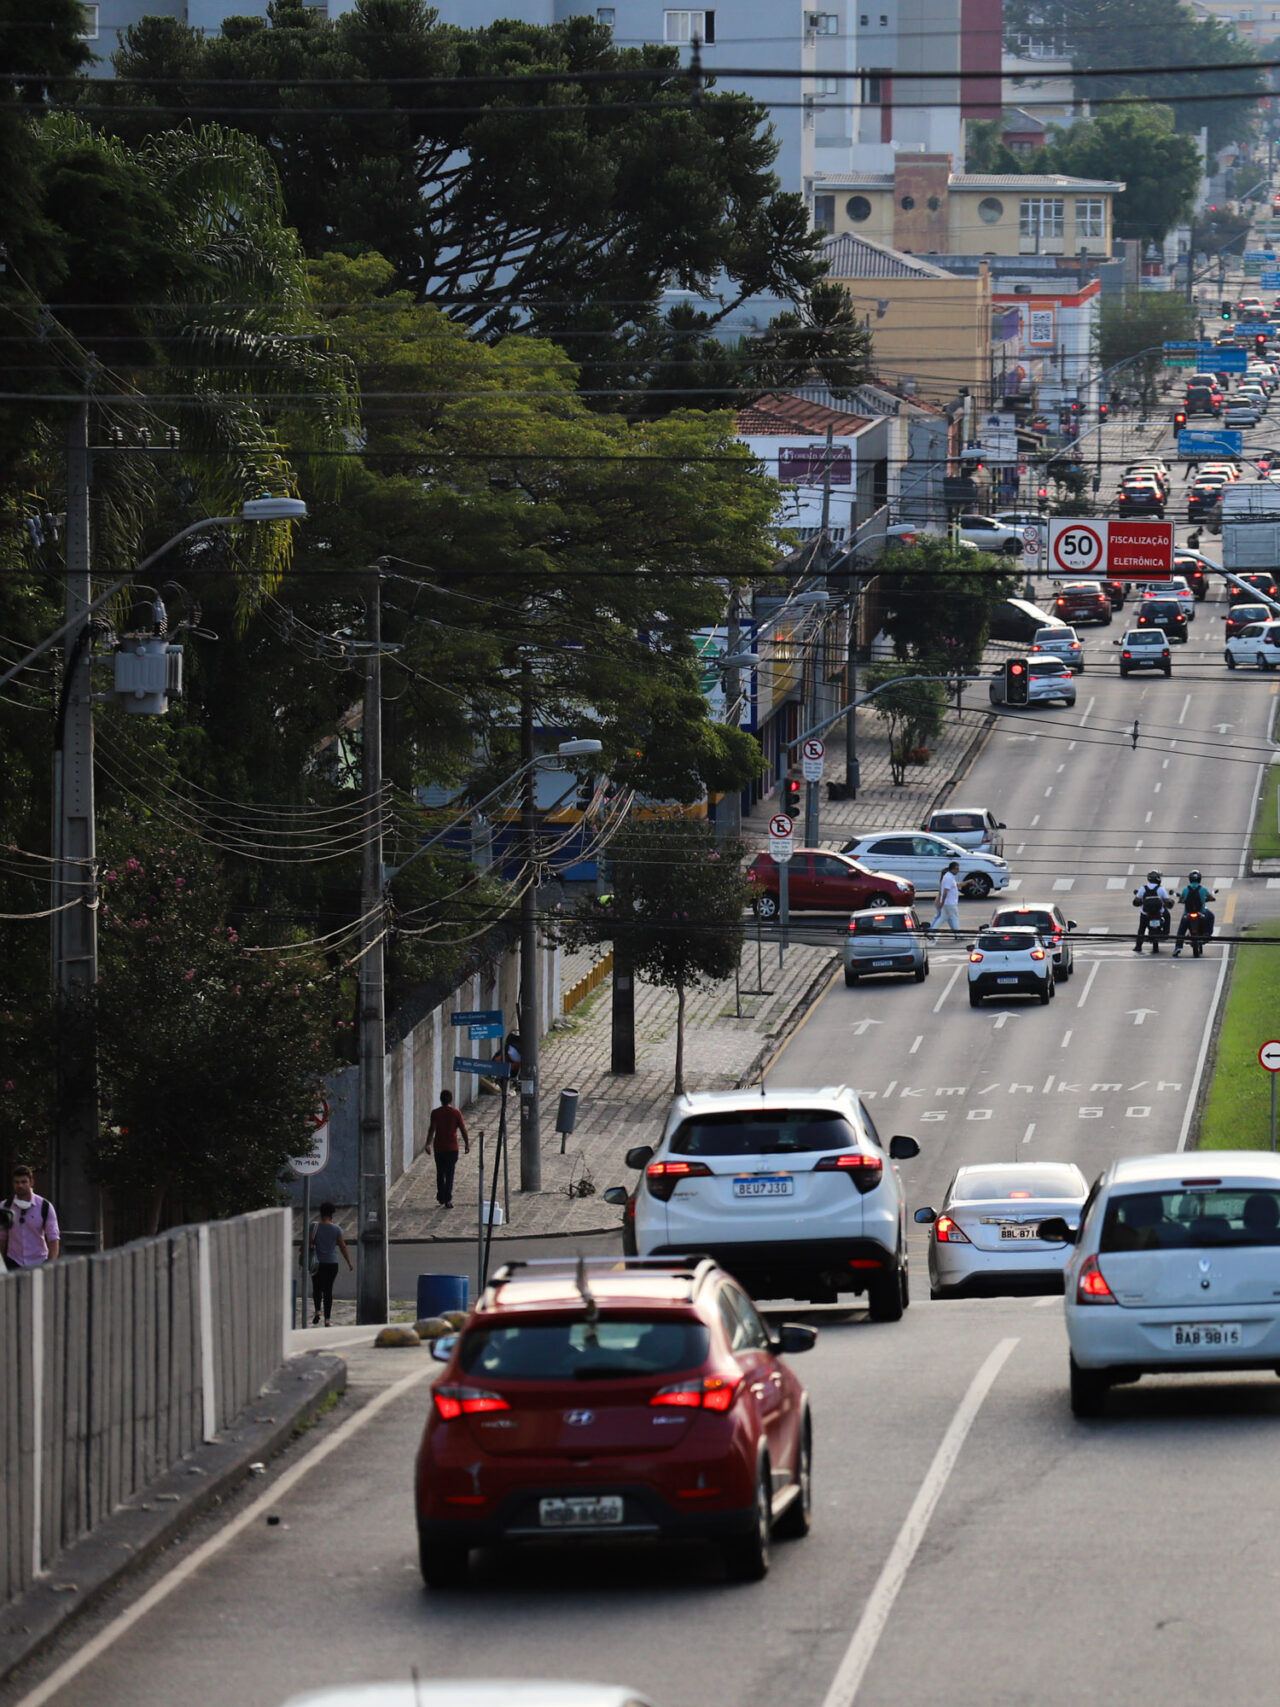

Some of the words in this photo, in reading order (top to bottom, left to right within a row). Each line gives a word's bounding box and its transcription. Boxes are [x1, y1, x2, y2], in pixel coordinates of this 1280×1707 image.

[1064, 535, 1093, 555] 50
[1110, 535, 1169, 546] FISCALIZAÇÃO
[1113, 556, 1164, 566] ELETRÔNICA
[900, 1083, 1029, 1098] km/h
[1057, 1080, 1183, 1093] km/h
[919, 1108, 993, 1122] 50
[1078, 1106, 1152, 1119] 50
[739, 1183, 787, 1194] BEU7J30
